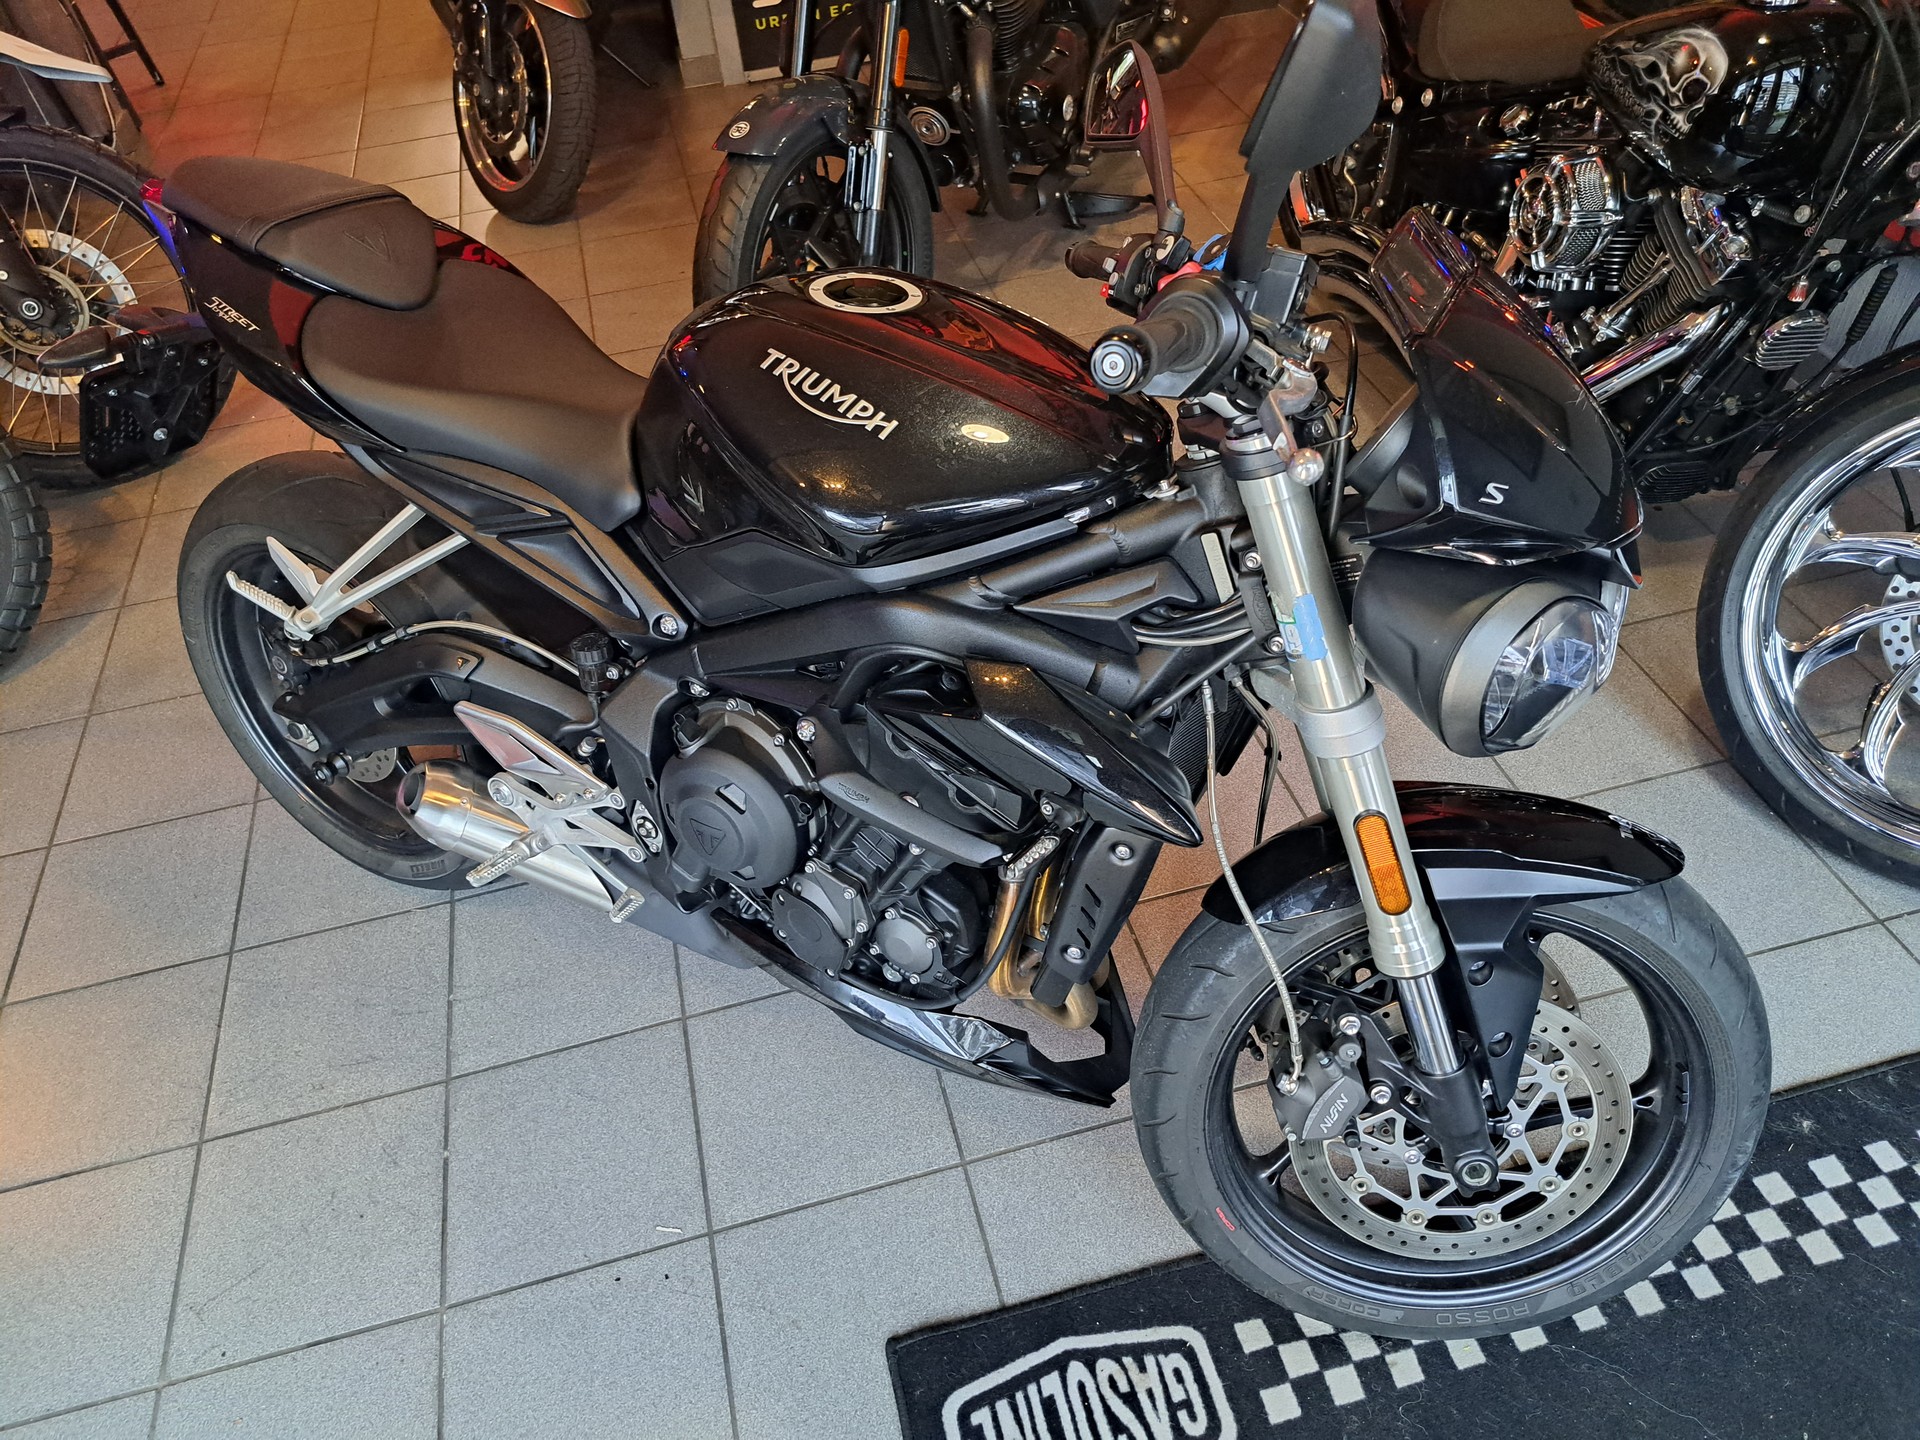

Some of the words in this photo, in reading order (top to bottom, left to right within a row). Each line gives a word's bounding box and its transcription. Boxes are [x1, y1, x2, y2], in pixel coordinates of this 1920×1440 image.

[204, 296, 261, 331] STREET
[760, 347, 899, 441] TRIUMPH
[1479, 482, 1509, 505] S
[838, 782, 870, 804] TRIUMPH
[1320, 1093, 1349, 1134] NISSIN
[1307, 1286, 1381, 1317] CORSA
[1436, 1302, 1531, 1326] ROSSO
